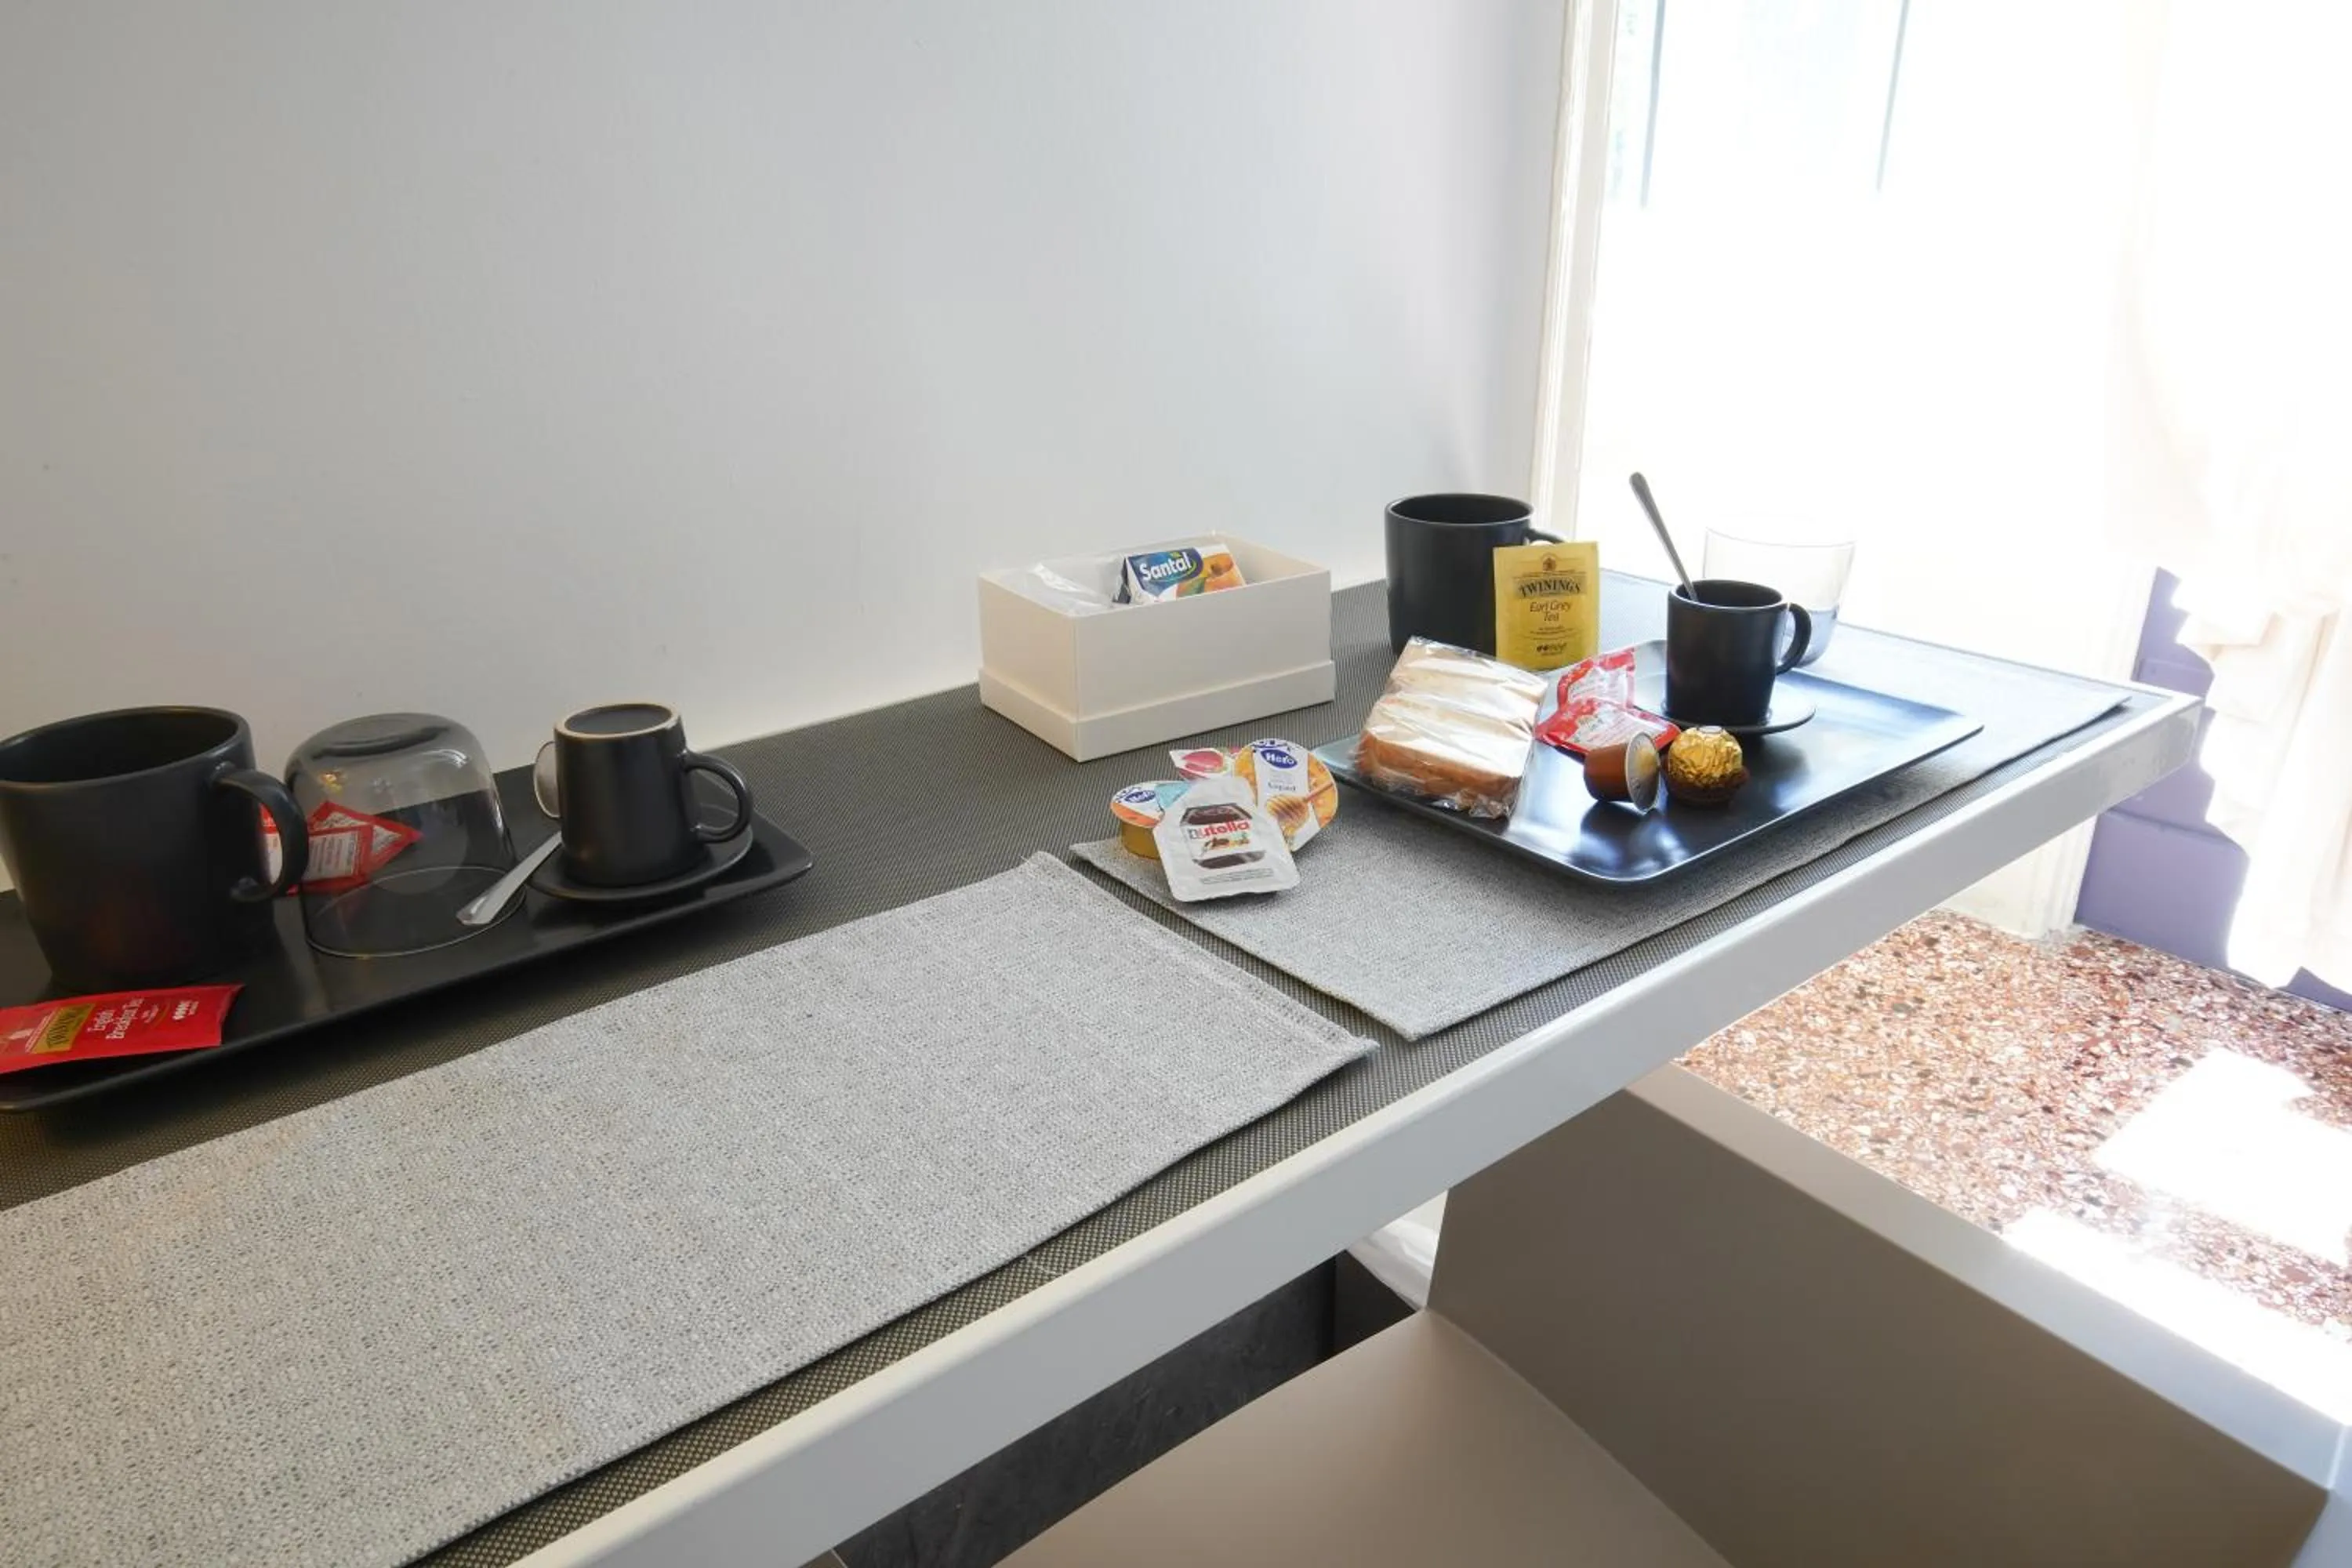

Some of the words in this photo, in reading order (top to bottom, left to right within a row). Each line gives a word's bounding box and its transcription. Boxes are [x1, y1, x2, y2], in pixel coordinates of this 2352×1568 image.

[1139, 551, 1192, 581] Santal
[1518, 579, 1581, 597] TWININGS
[1265, 752, 1295, 765] Hero
[1189, 821, 1250, 840] nutella
